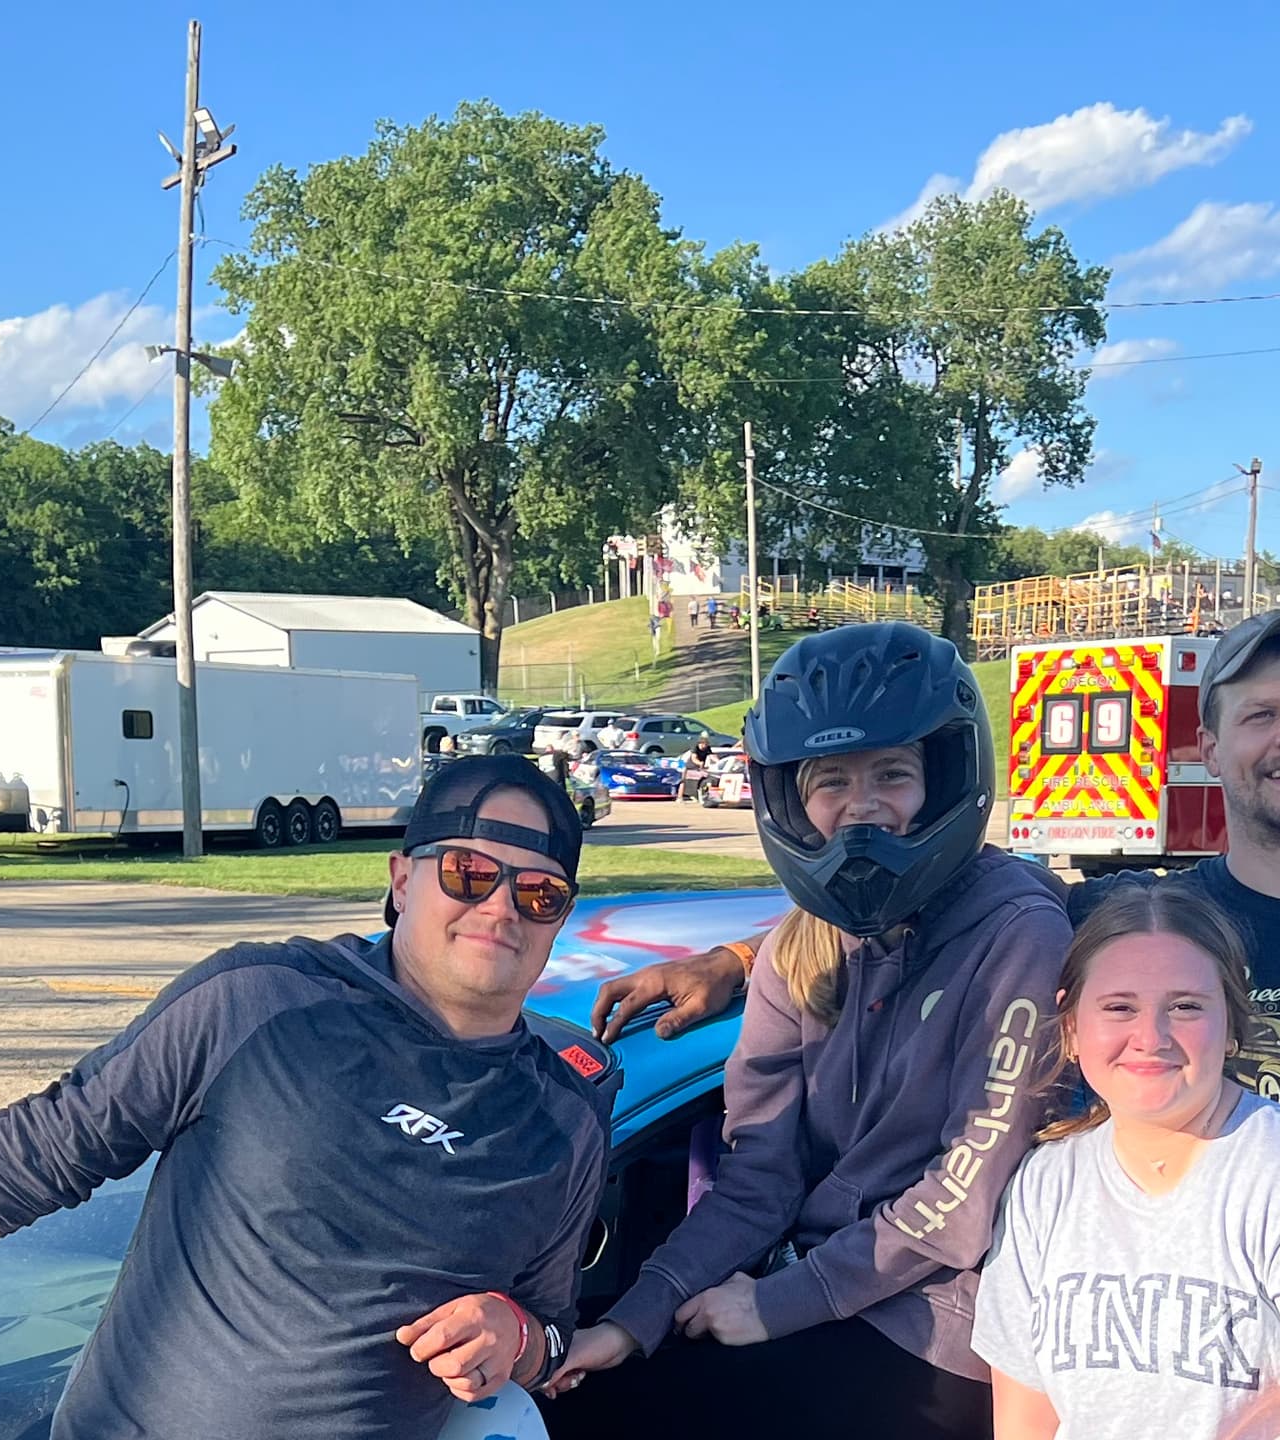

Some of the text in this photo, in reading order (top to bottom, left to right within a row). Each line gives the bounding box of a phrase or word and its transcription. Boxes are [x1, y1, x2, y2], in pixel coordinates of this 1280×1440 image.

[1059, 675, 1118, 689] OREGON
[1050, 701, 1123, 745] 6 9
[814, 731, 855, 744] BELL
[1041, 775, 1129, 788] FIRE RESCUE
[1042, 799, 1126, 812] AMBULANCE
[1047, 826, 1117, 840] OREGON FIRE
[380, 1103, 465, 1155] RFK
